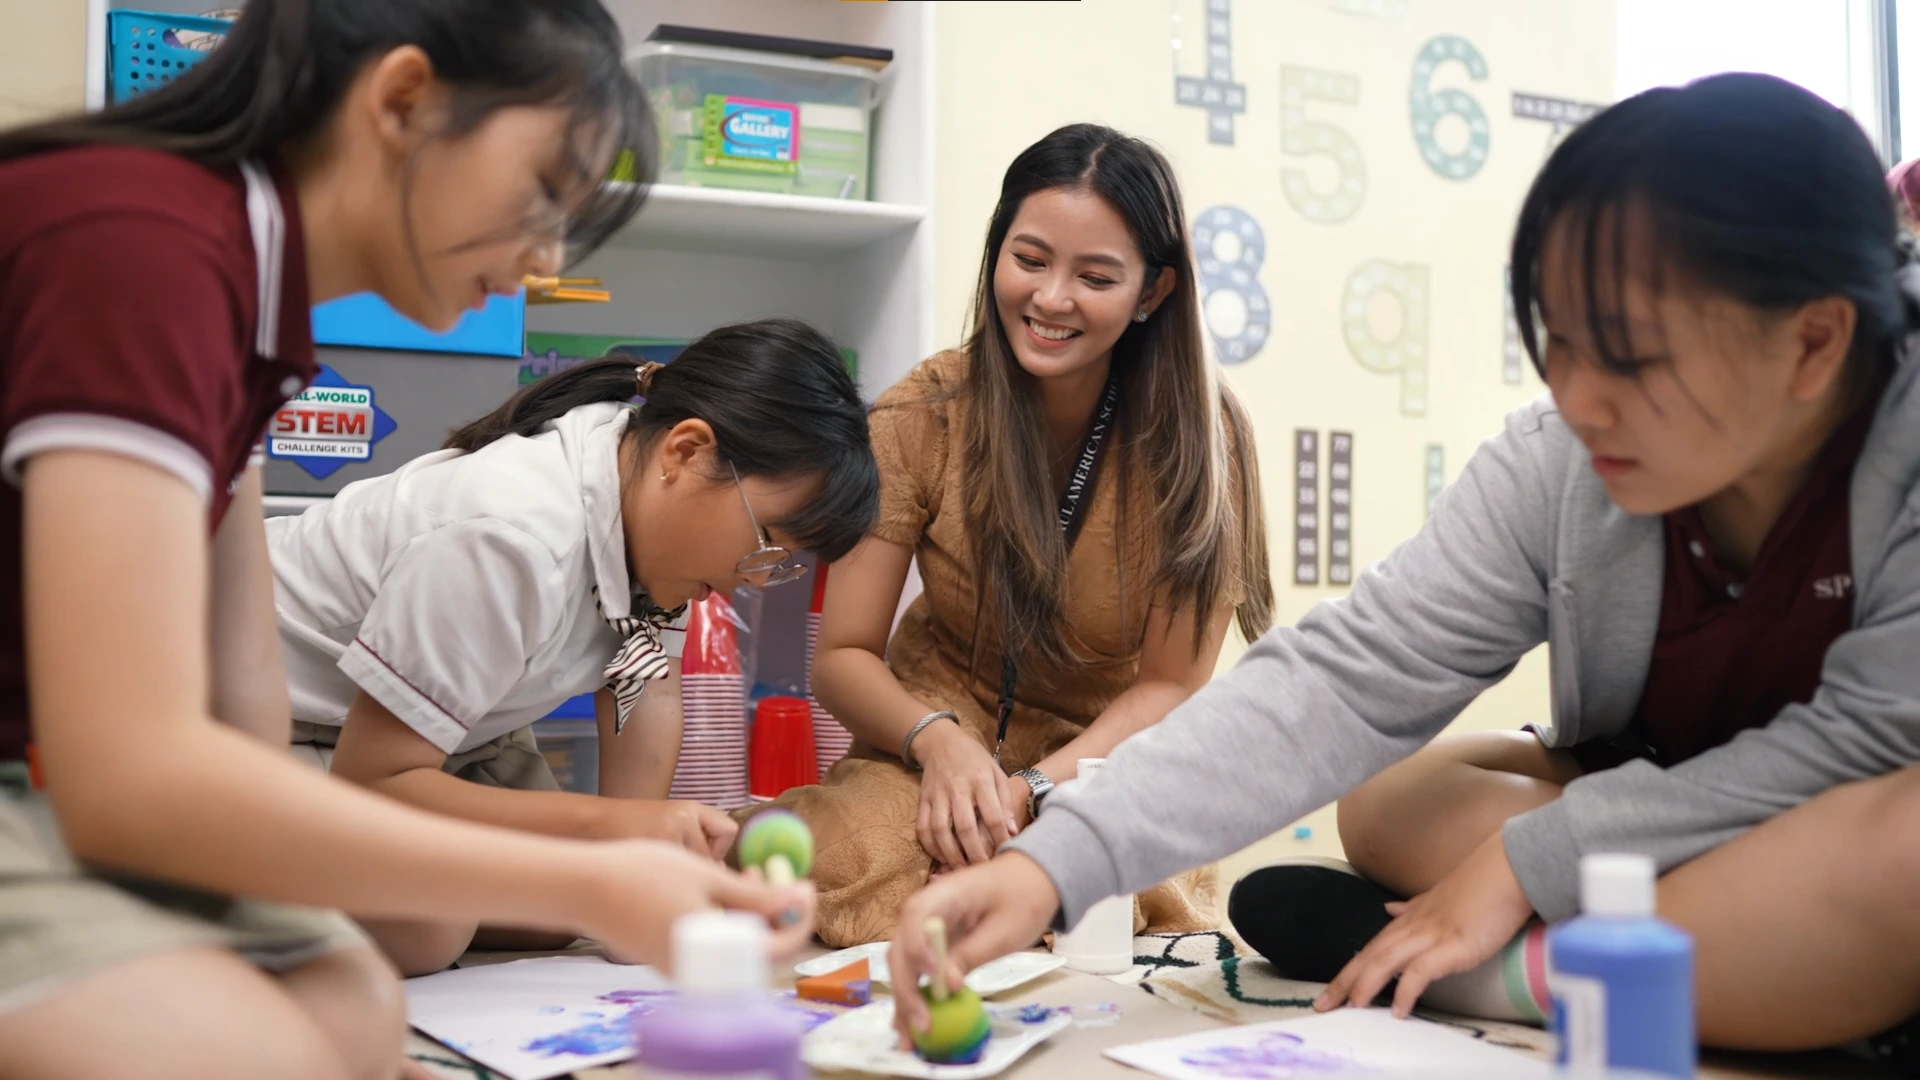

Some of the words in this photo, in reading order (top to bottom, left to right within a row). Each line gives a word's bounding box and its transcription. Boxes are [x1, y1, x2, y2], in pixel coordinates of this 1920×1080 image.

[1409, 35, 1490, 181] 6
[730, 118, 790, 139] GALLERY
[1280, 64, 1369, 225] 5
[1192, 205, 1271, 368] 8
[293, 391, 368, 404] AL-WORLD
[275, 409, 366, 436] STEM
[277, 442, 337, 453] CHALLENGE
[340, 444, 363, 454] KITS
[1067, 422, 1106, 505] AMERICAN
[1812, 574, 1852, 599] SP
